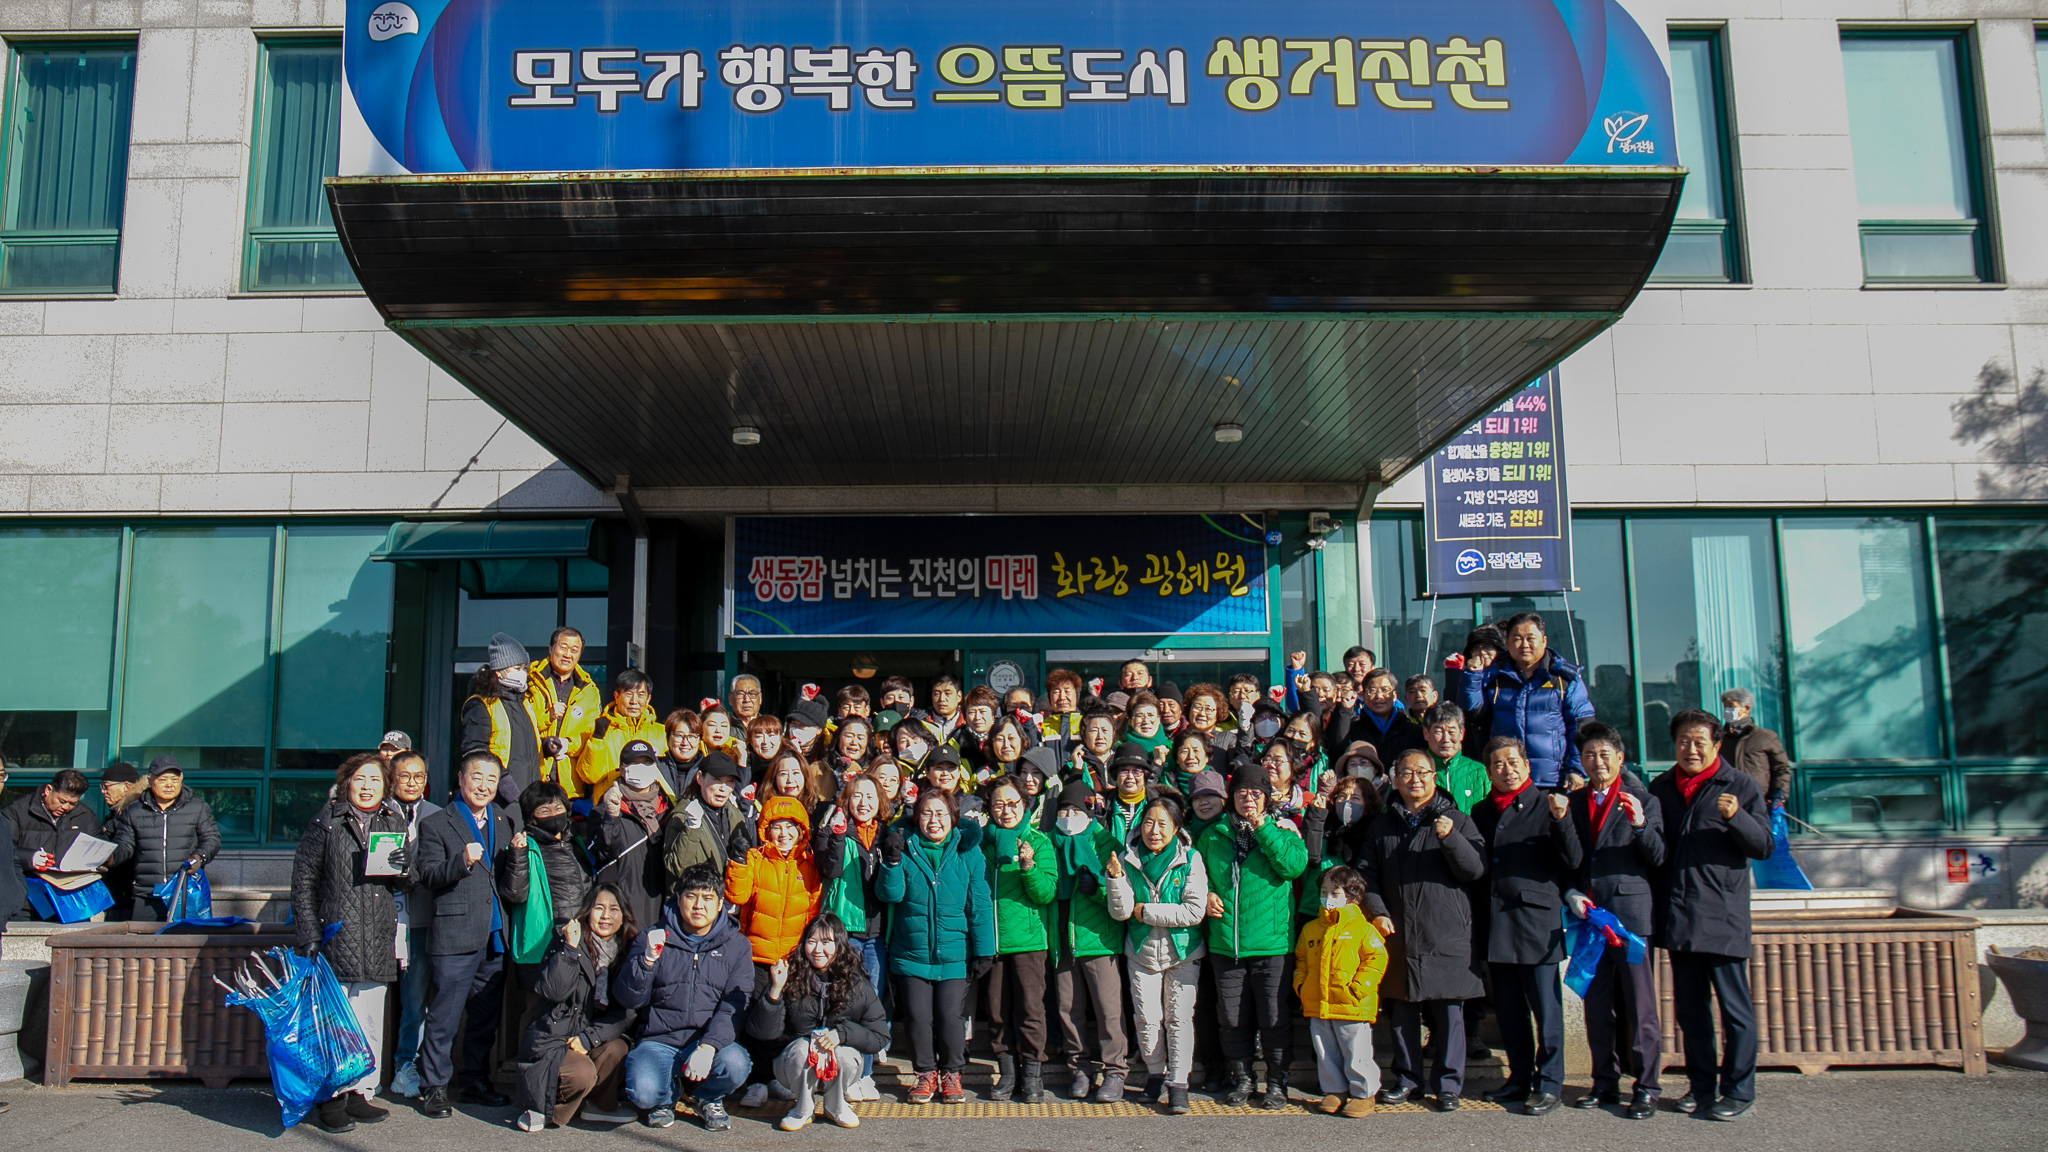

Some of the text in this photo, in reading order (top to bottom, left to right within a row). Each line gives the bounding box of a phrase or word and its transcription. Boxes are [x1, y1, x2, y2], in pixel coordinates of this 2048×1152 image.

[510, 36, 1511, 112] 모두가 행복한 으뜸도시 생거진천
[1515, 395, 1548, 413] 44%
[1485, 417, 1510, 435] 도내
[1513, 417, 1538, 435] 1위!
[1489, 441, 1524, 459] 충청권
[1527, 441, 1551, 459] 1위!
[1442, 464, 1552, 484] 출생아수 증가율 도내 1위!
[1463, 490, 1539, 505] 지방 인구성장의
[1458, 509, 1544, 529] 새로운 기준, 진천!
[1487, 551, 1543, 570] 진천군
[748, 549, 1250, 602] 생동감 넘치는 진천의 미래 화랑 광혜원
